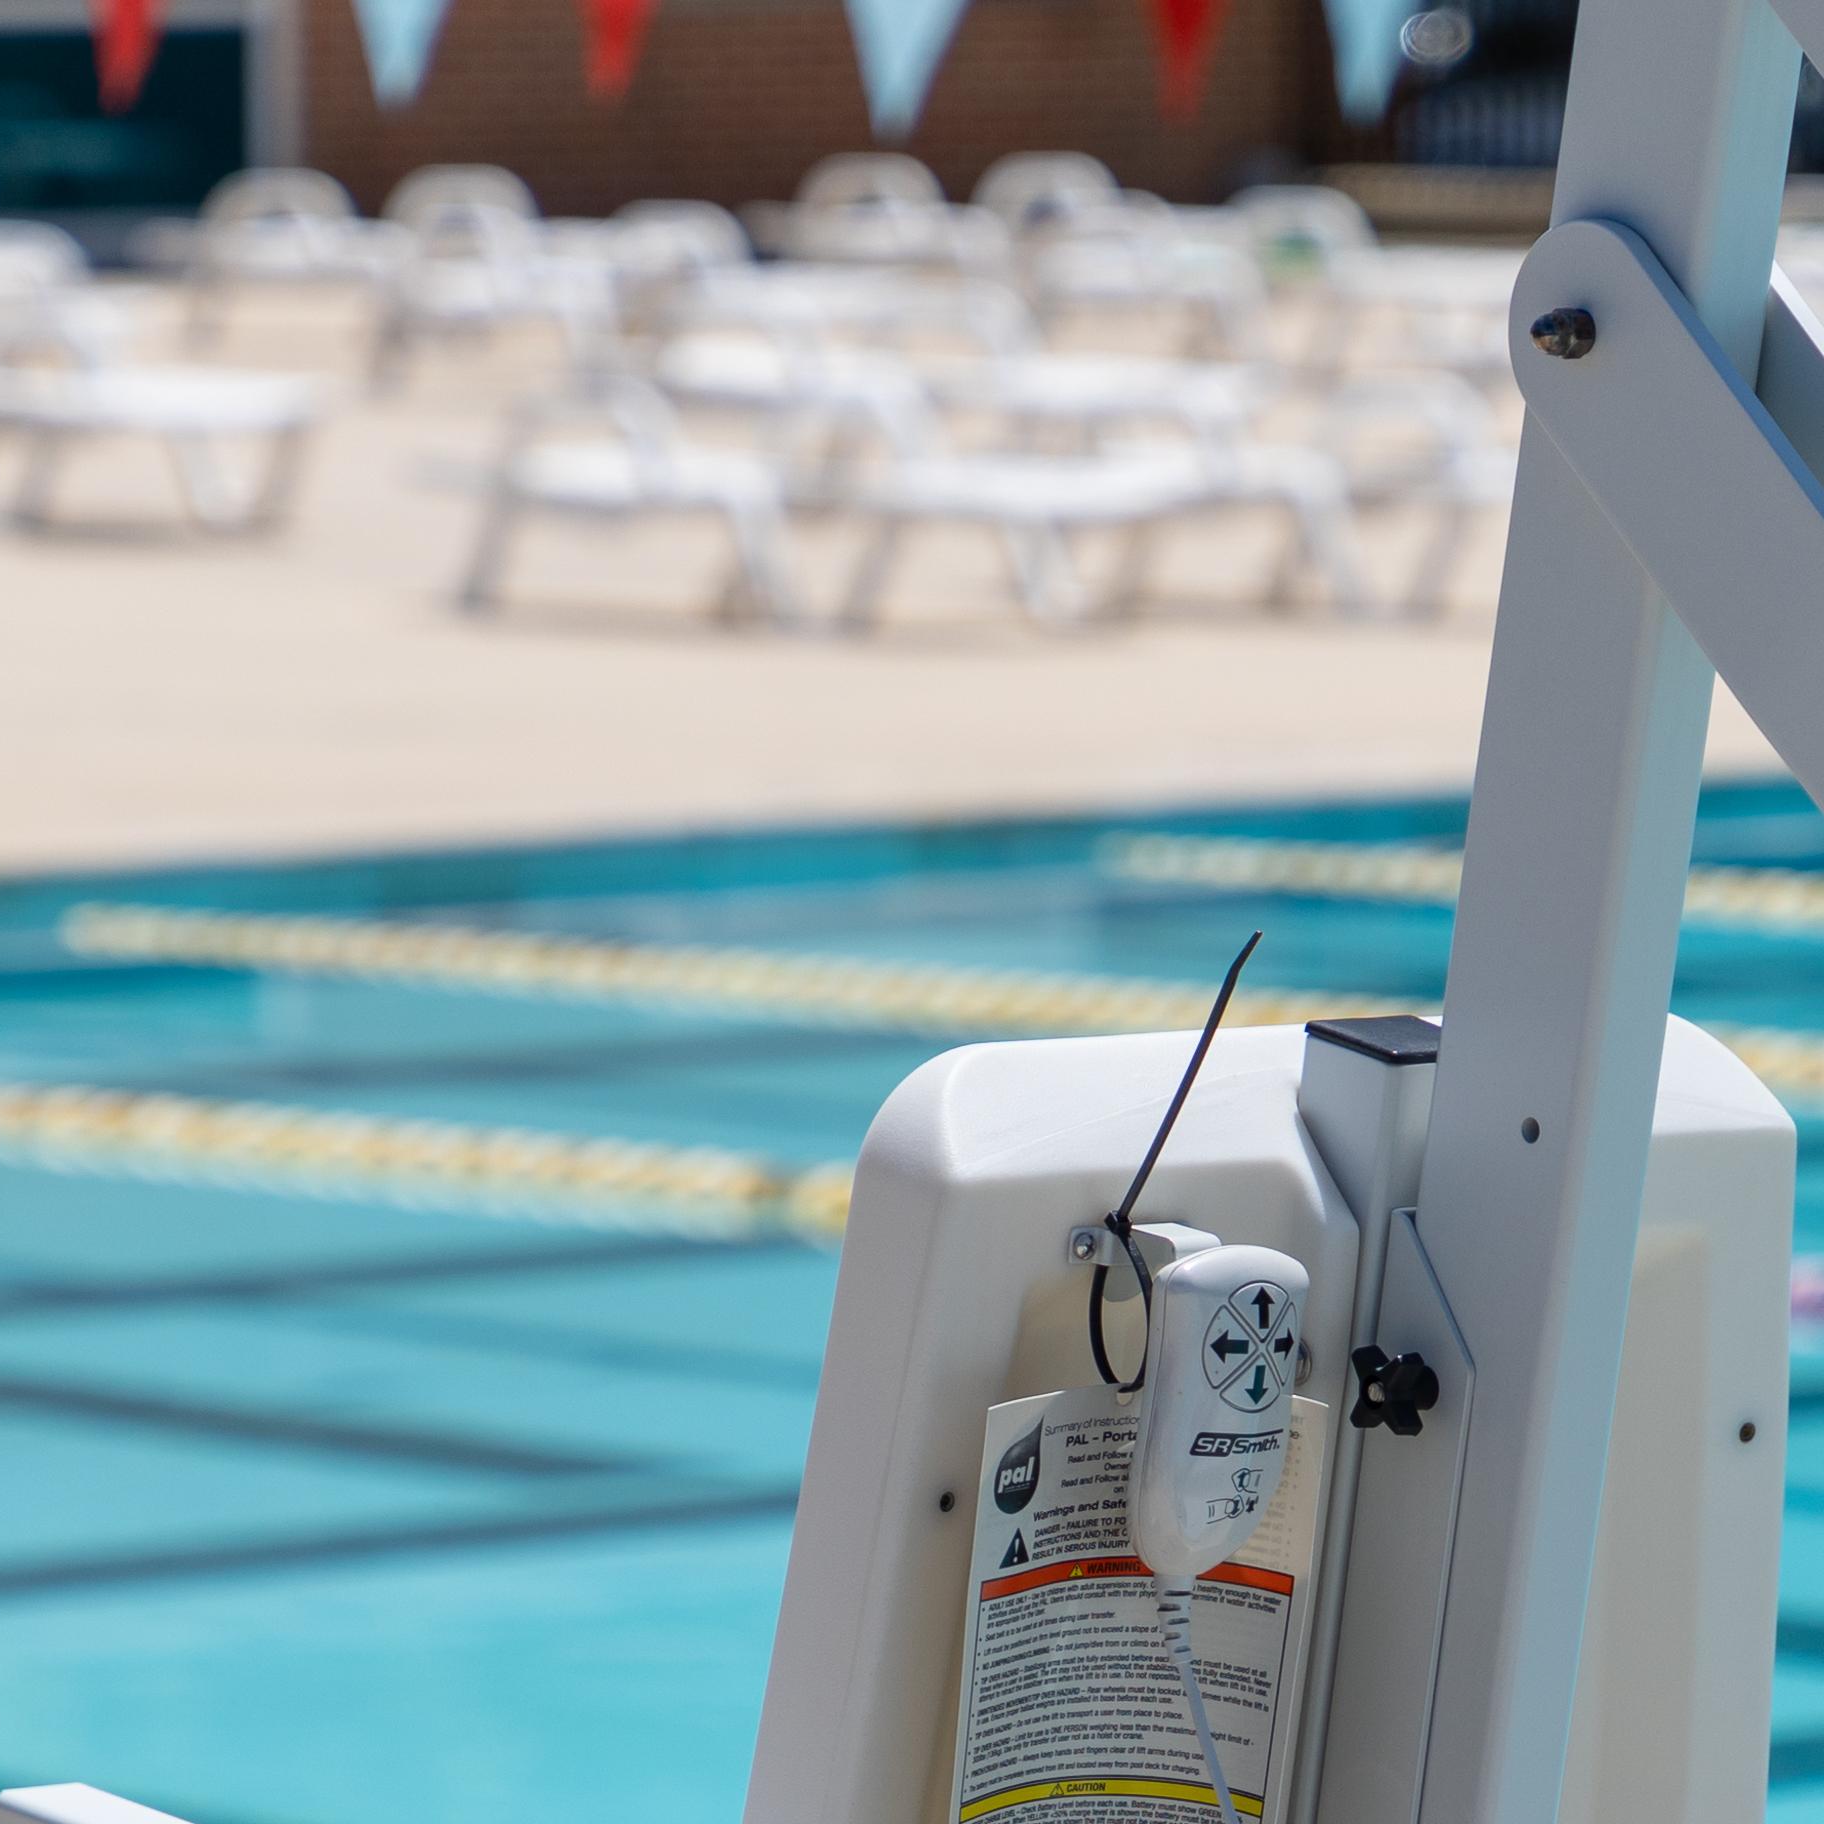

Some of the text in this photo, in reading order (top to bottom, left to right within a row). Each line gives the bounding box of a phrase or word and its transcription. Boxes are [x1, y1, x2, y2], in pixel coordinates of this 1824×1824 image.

[1044, 1423, 1081, 1437] Summary
[1083, 1418, 1092, 1429] of
[1066, 1435, 1089, 1447] PAL
[1194, 1436, 1232, 1454] SR
[1068, 1454, 1086, 1464] Read
[1087, 1452, 1101, 1462] and
[1102, 1451, 1126, 1460] Follow
[997, 1456, 1035, 1494] pal
[1061, 1478, 1078, 1488] Read
[1079, 1476, 1093, 1485] and
[1095, 1474, 1120, 1484] Follow
[1033, 1506, 1075, 1522] Warnings
[1078, 1501, 1099, 1512] and
[1034, 1525, 1061, 1538] DANGER
[1066, 1519, 1099, 1530] FAILURE
[1101, 1518, 1112, 1526] TO
[1033, 1534, 1082, 1549] INSTRUCTIONS
[1083, 1531, 1100, 1542] AND
[1103, 1530, 1120, 1538] THE
[1032, 1548, 1055, 1561] RESULT
[1056, 1547, 1064, 1555] IN
[1098, 1540, 1130, 1549] INJURY
[1087, 1561, 1140, 1574] WARNING
[1080, 1582, 1095, 1591] adult
[1096, 1581, 1131, 1589] supervision
[1133, 1580, 1149, 1589] only.
[1225, 1589, 1251, 1599] enough
[1108, 1590, 1120, 1598] with
[1122, 1589, 1136, 1597] their
[1131, 1626, 1149, 1634] slope
[1131, 1654, 1153, 1662] before
[1157, 1687, 1182, 1696] locked
[1133, 1710, 1152, 1718] place
[1066, 1782, 1106, 1793] CAUTION
